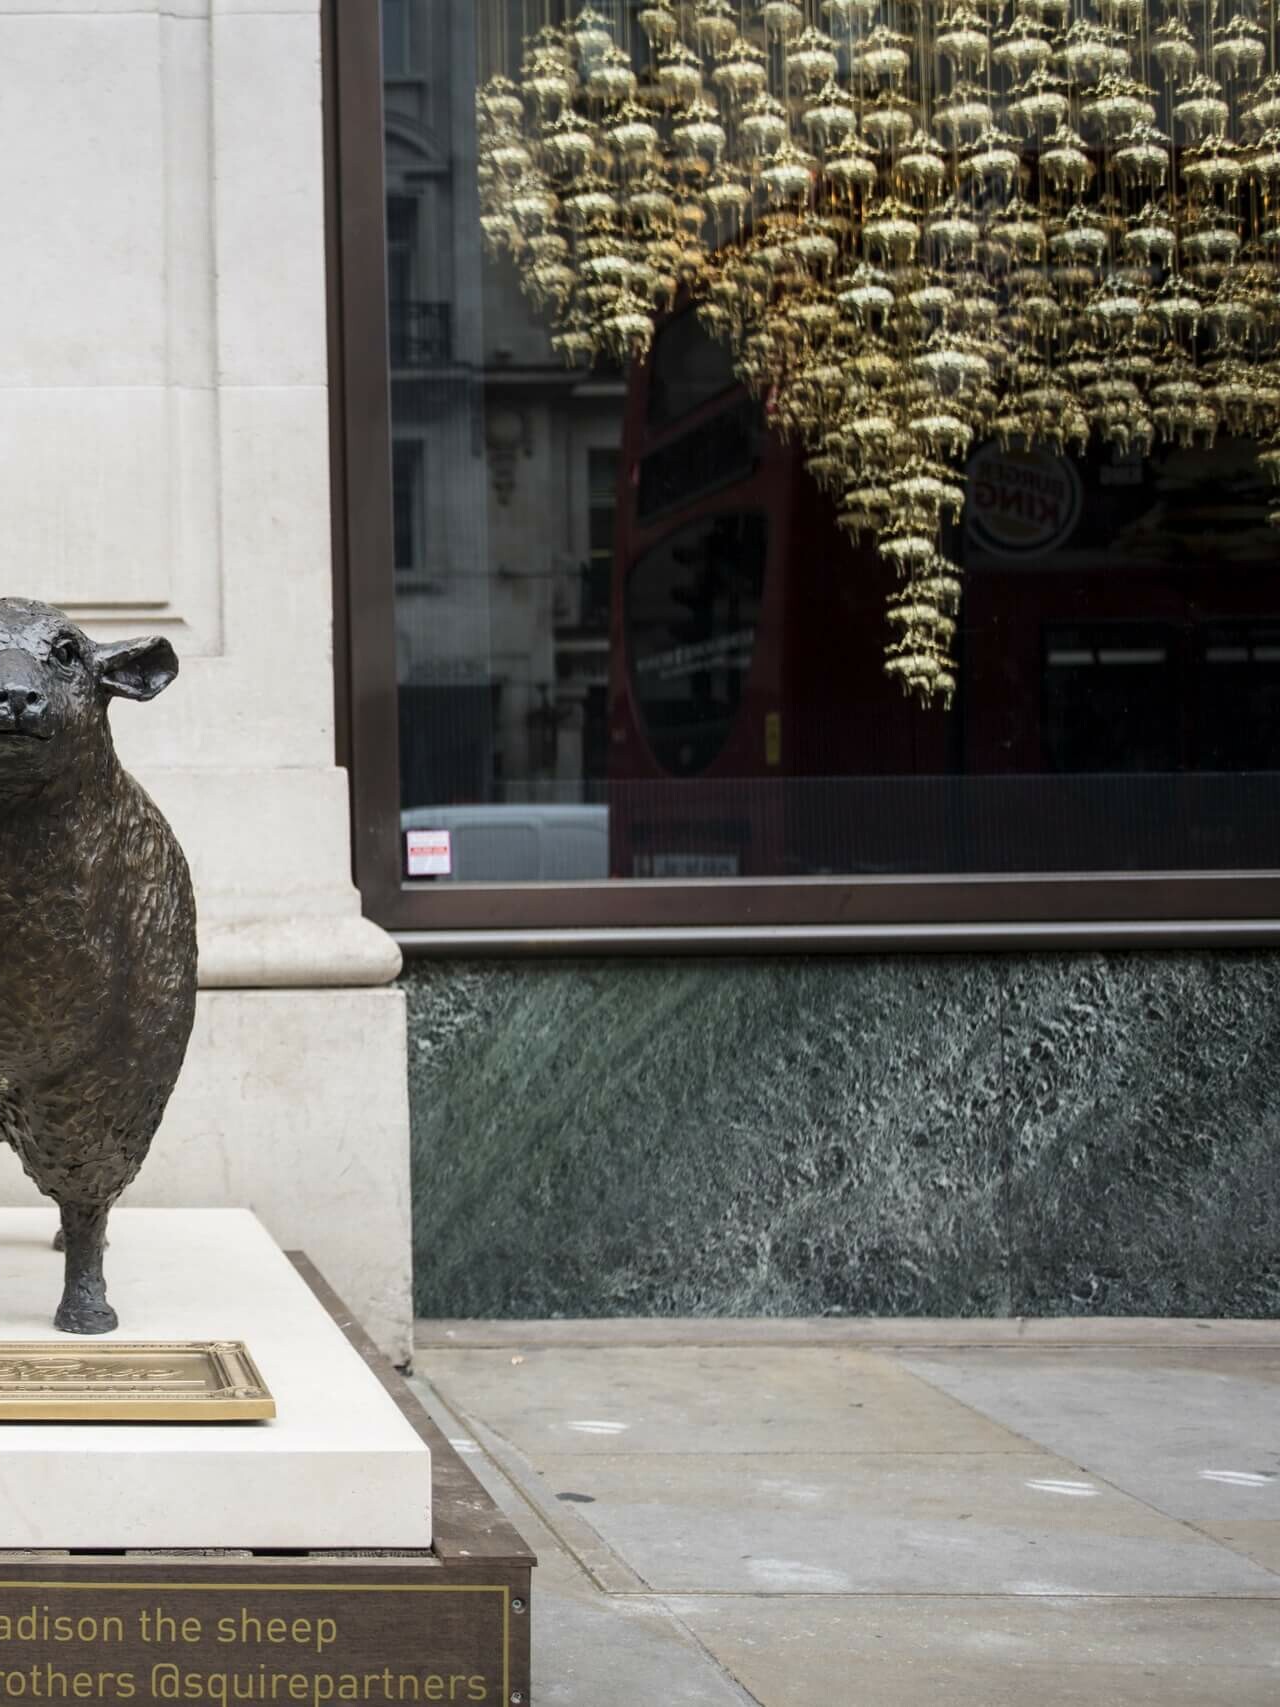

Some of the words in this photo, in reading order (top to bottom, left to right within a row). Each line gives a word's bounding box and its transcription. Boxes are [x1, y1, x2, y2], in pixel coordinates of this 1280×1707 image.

[139, 1608, 202, 1643] the
[216, 1608, 338, 1652] sheep
[151, 1663, 488, 1707] @squirepartners
